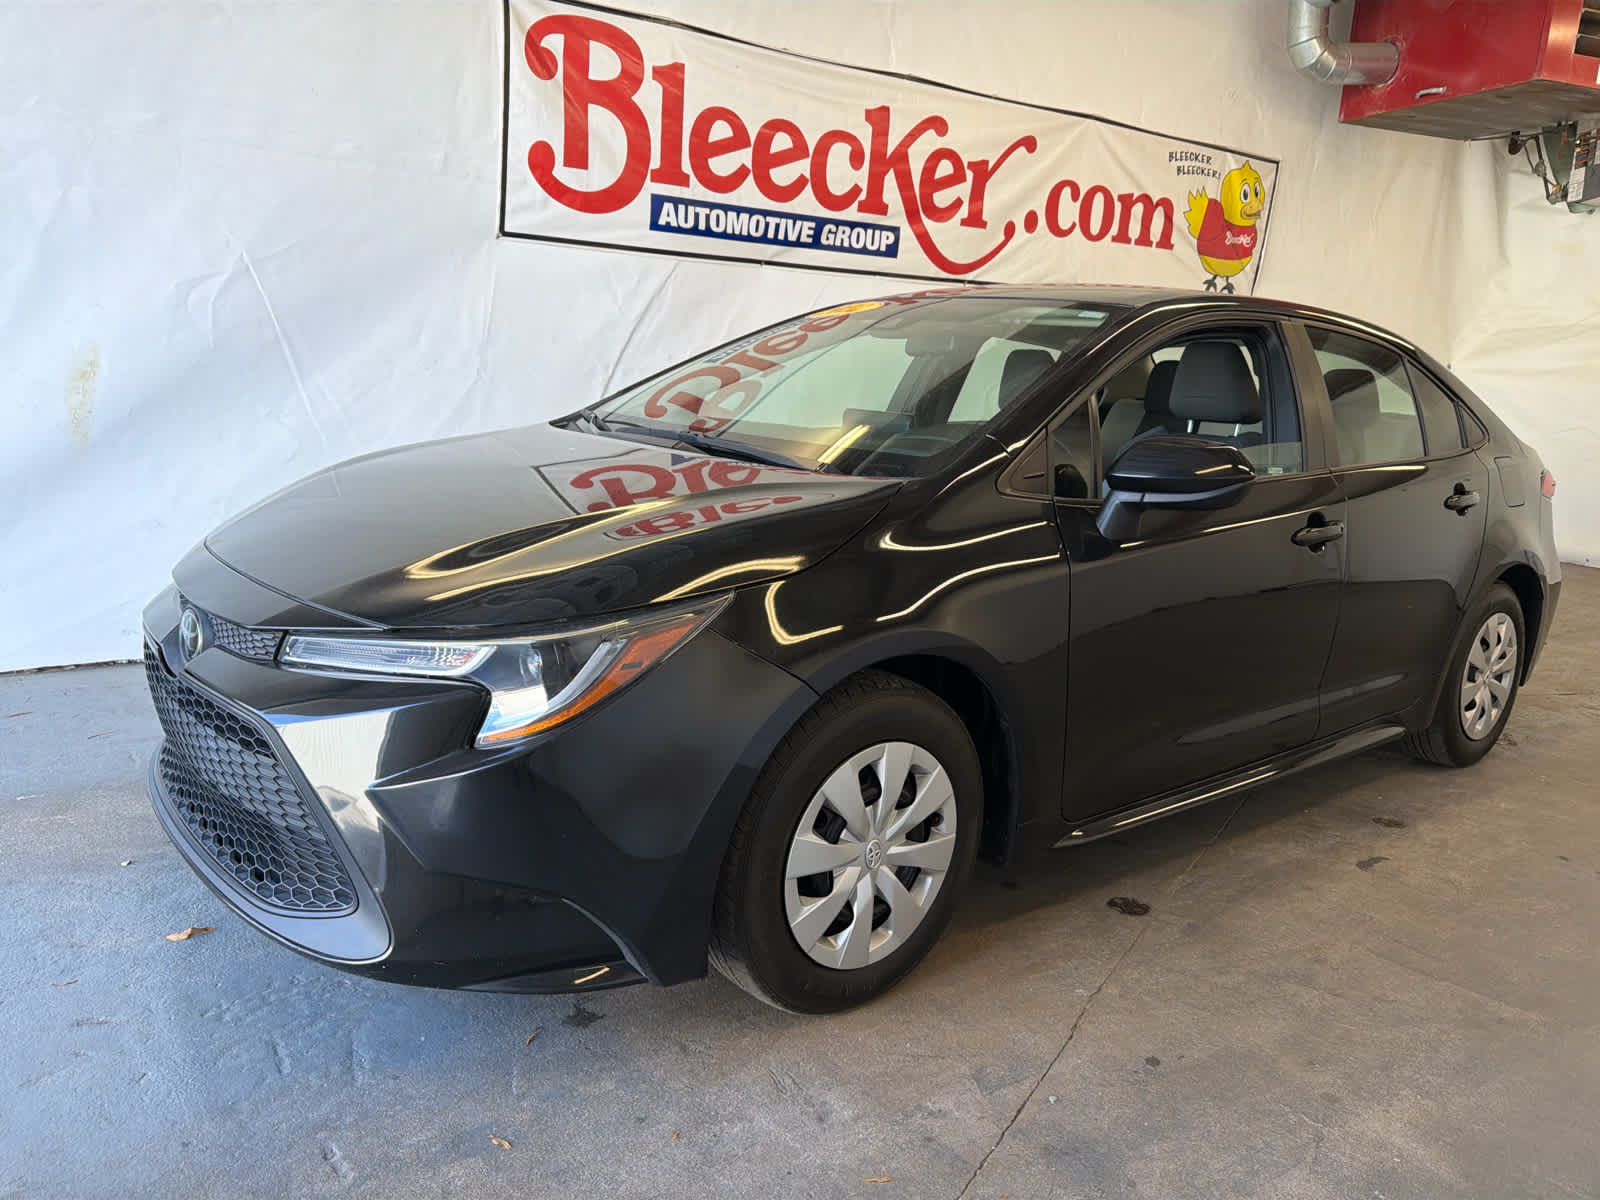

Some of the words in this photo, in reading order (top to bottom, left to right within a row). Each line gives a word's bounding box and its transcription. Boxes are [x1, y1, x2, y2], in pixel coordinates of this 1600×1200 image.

[1168, 151, 1213, 165] BLEECKER
[658, 202, 816, 243] AUTOMOTIVE
[820, 223, 895, 252] GROUP
